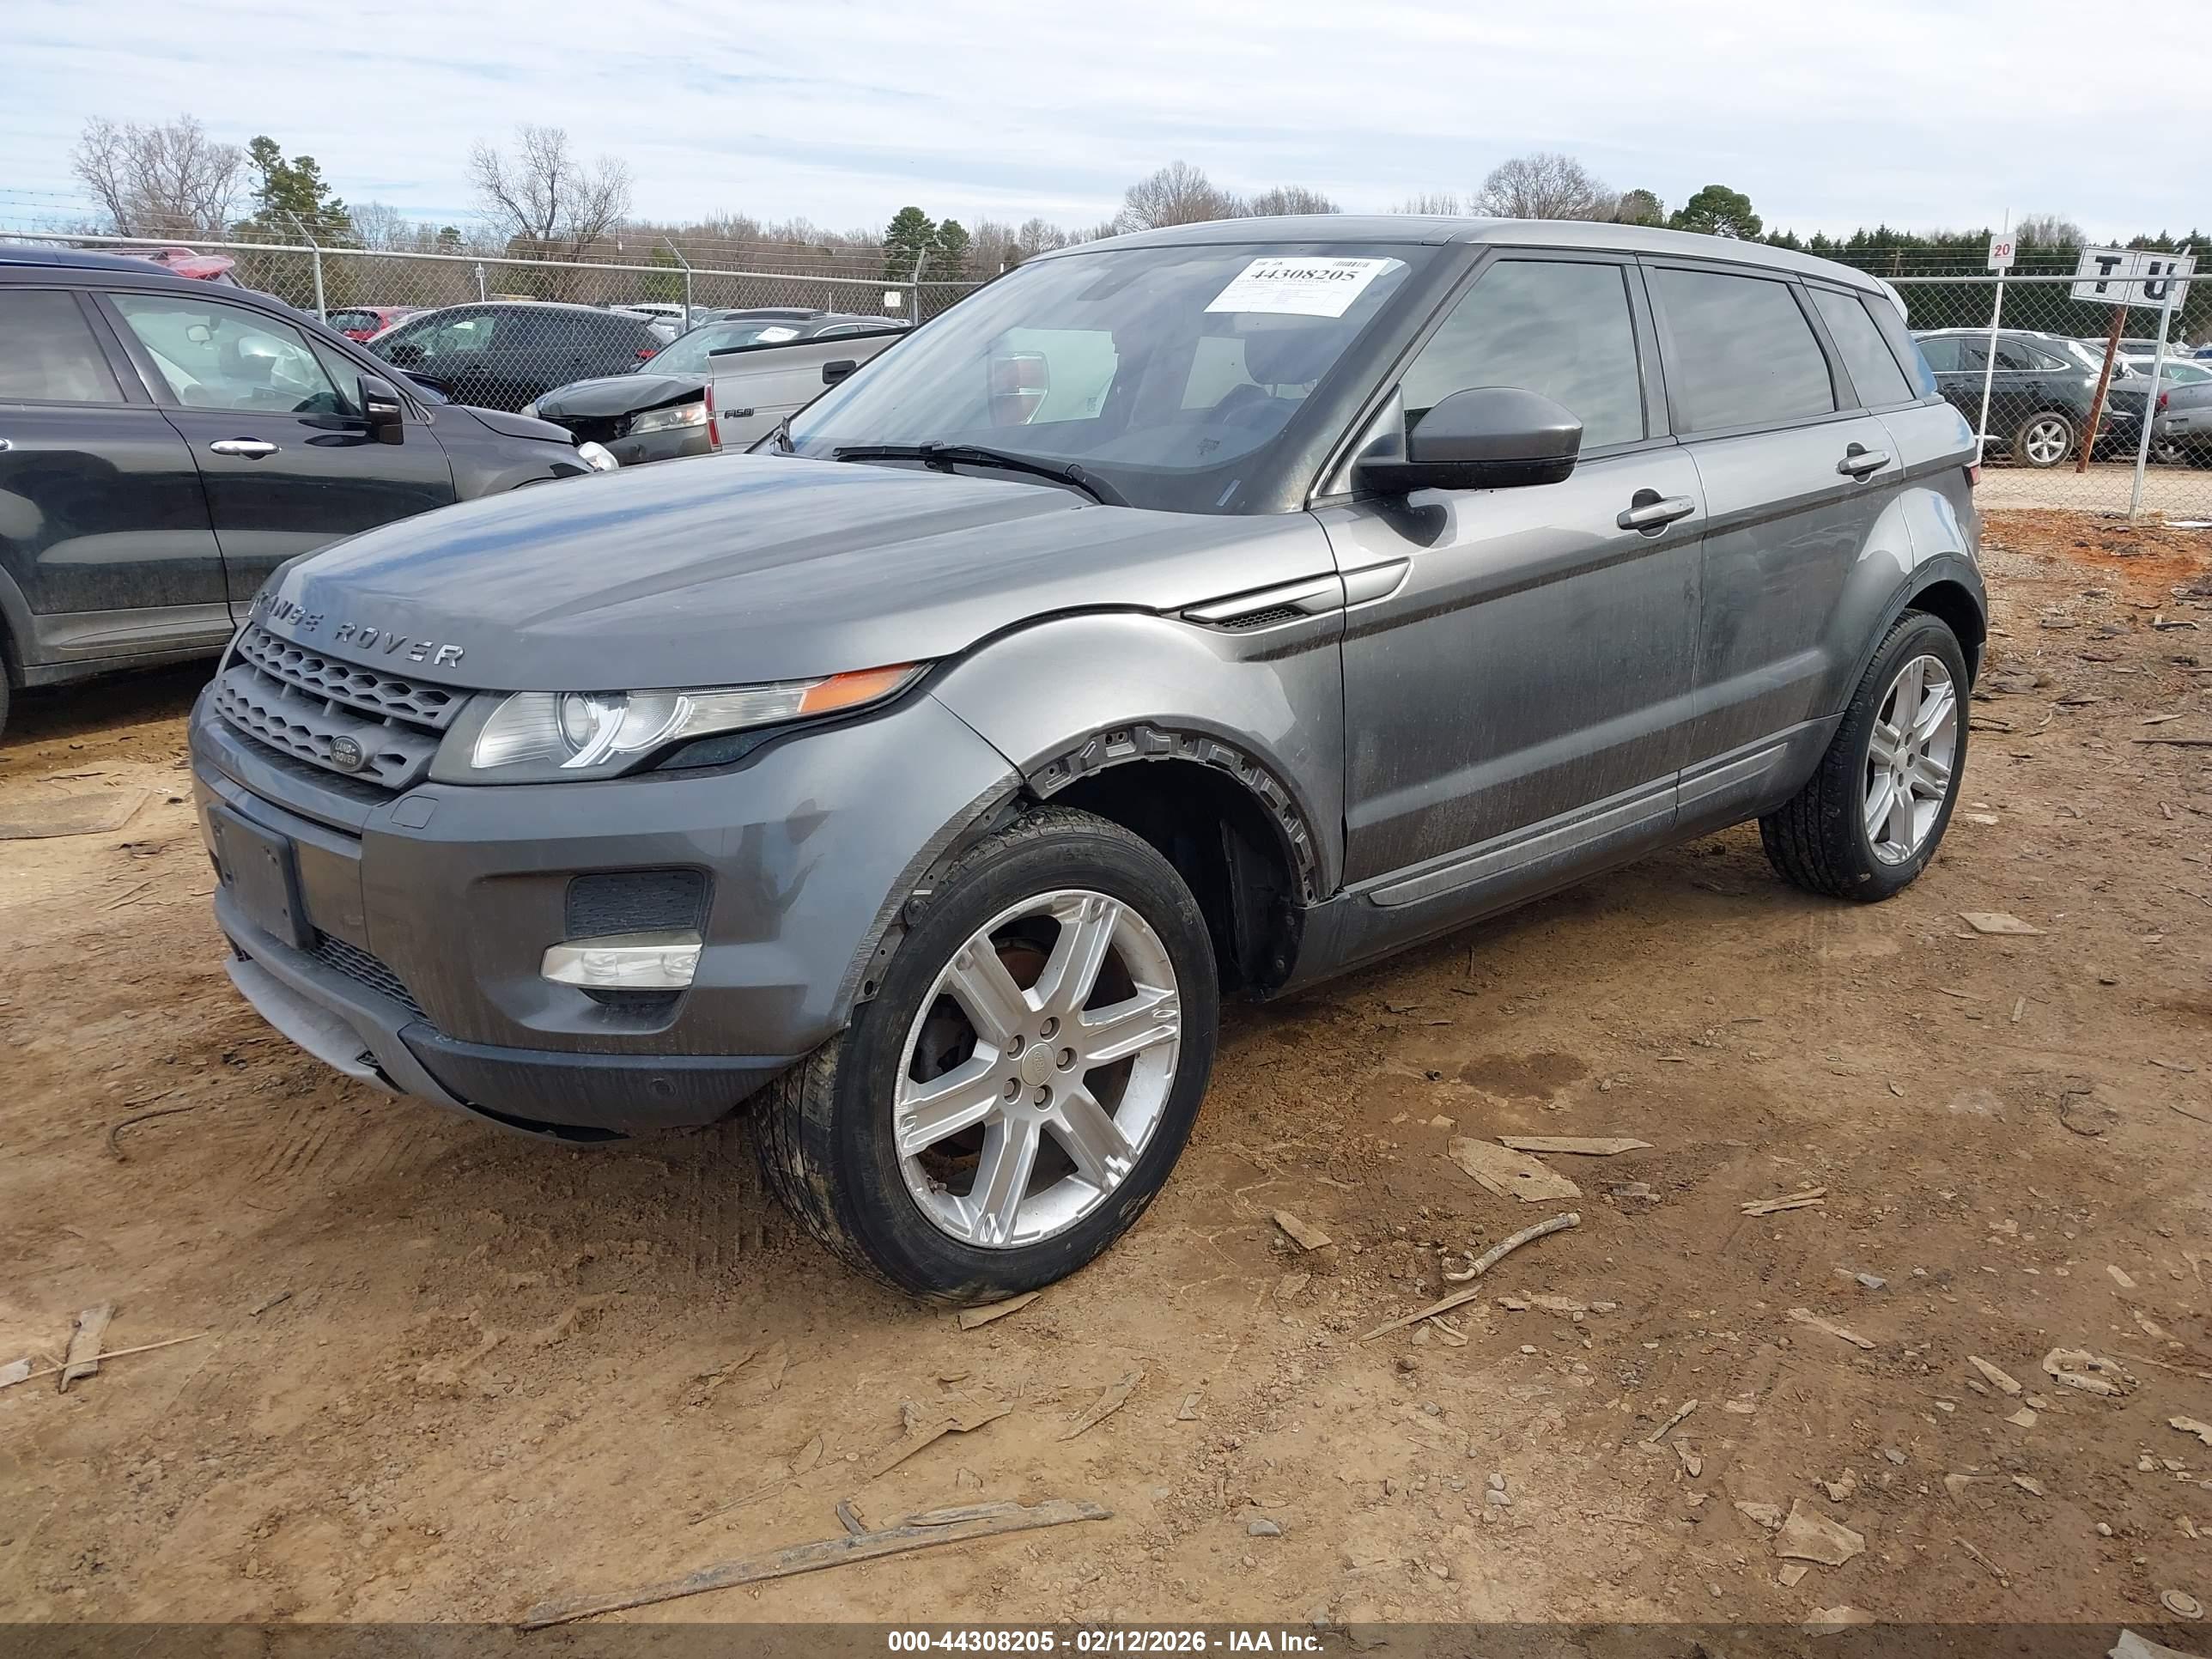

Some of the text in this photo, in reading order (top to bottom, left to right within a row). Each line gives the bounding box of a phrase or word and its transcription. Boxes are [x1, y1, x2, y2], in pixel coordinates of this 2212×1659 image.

[1994, 243, 2011, 257] 20
[1251, 269, 1359, 282] 44308205
[2094, 255, 2179, 301] T U
[331, 620, 465, 669] ROVER
